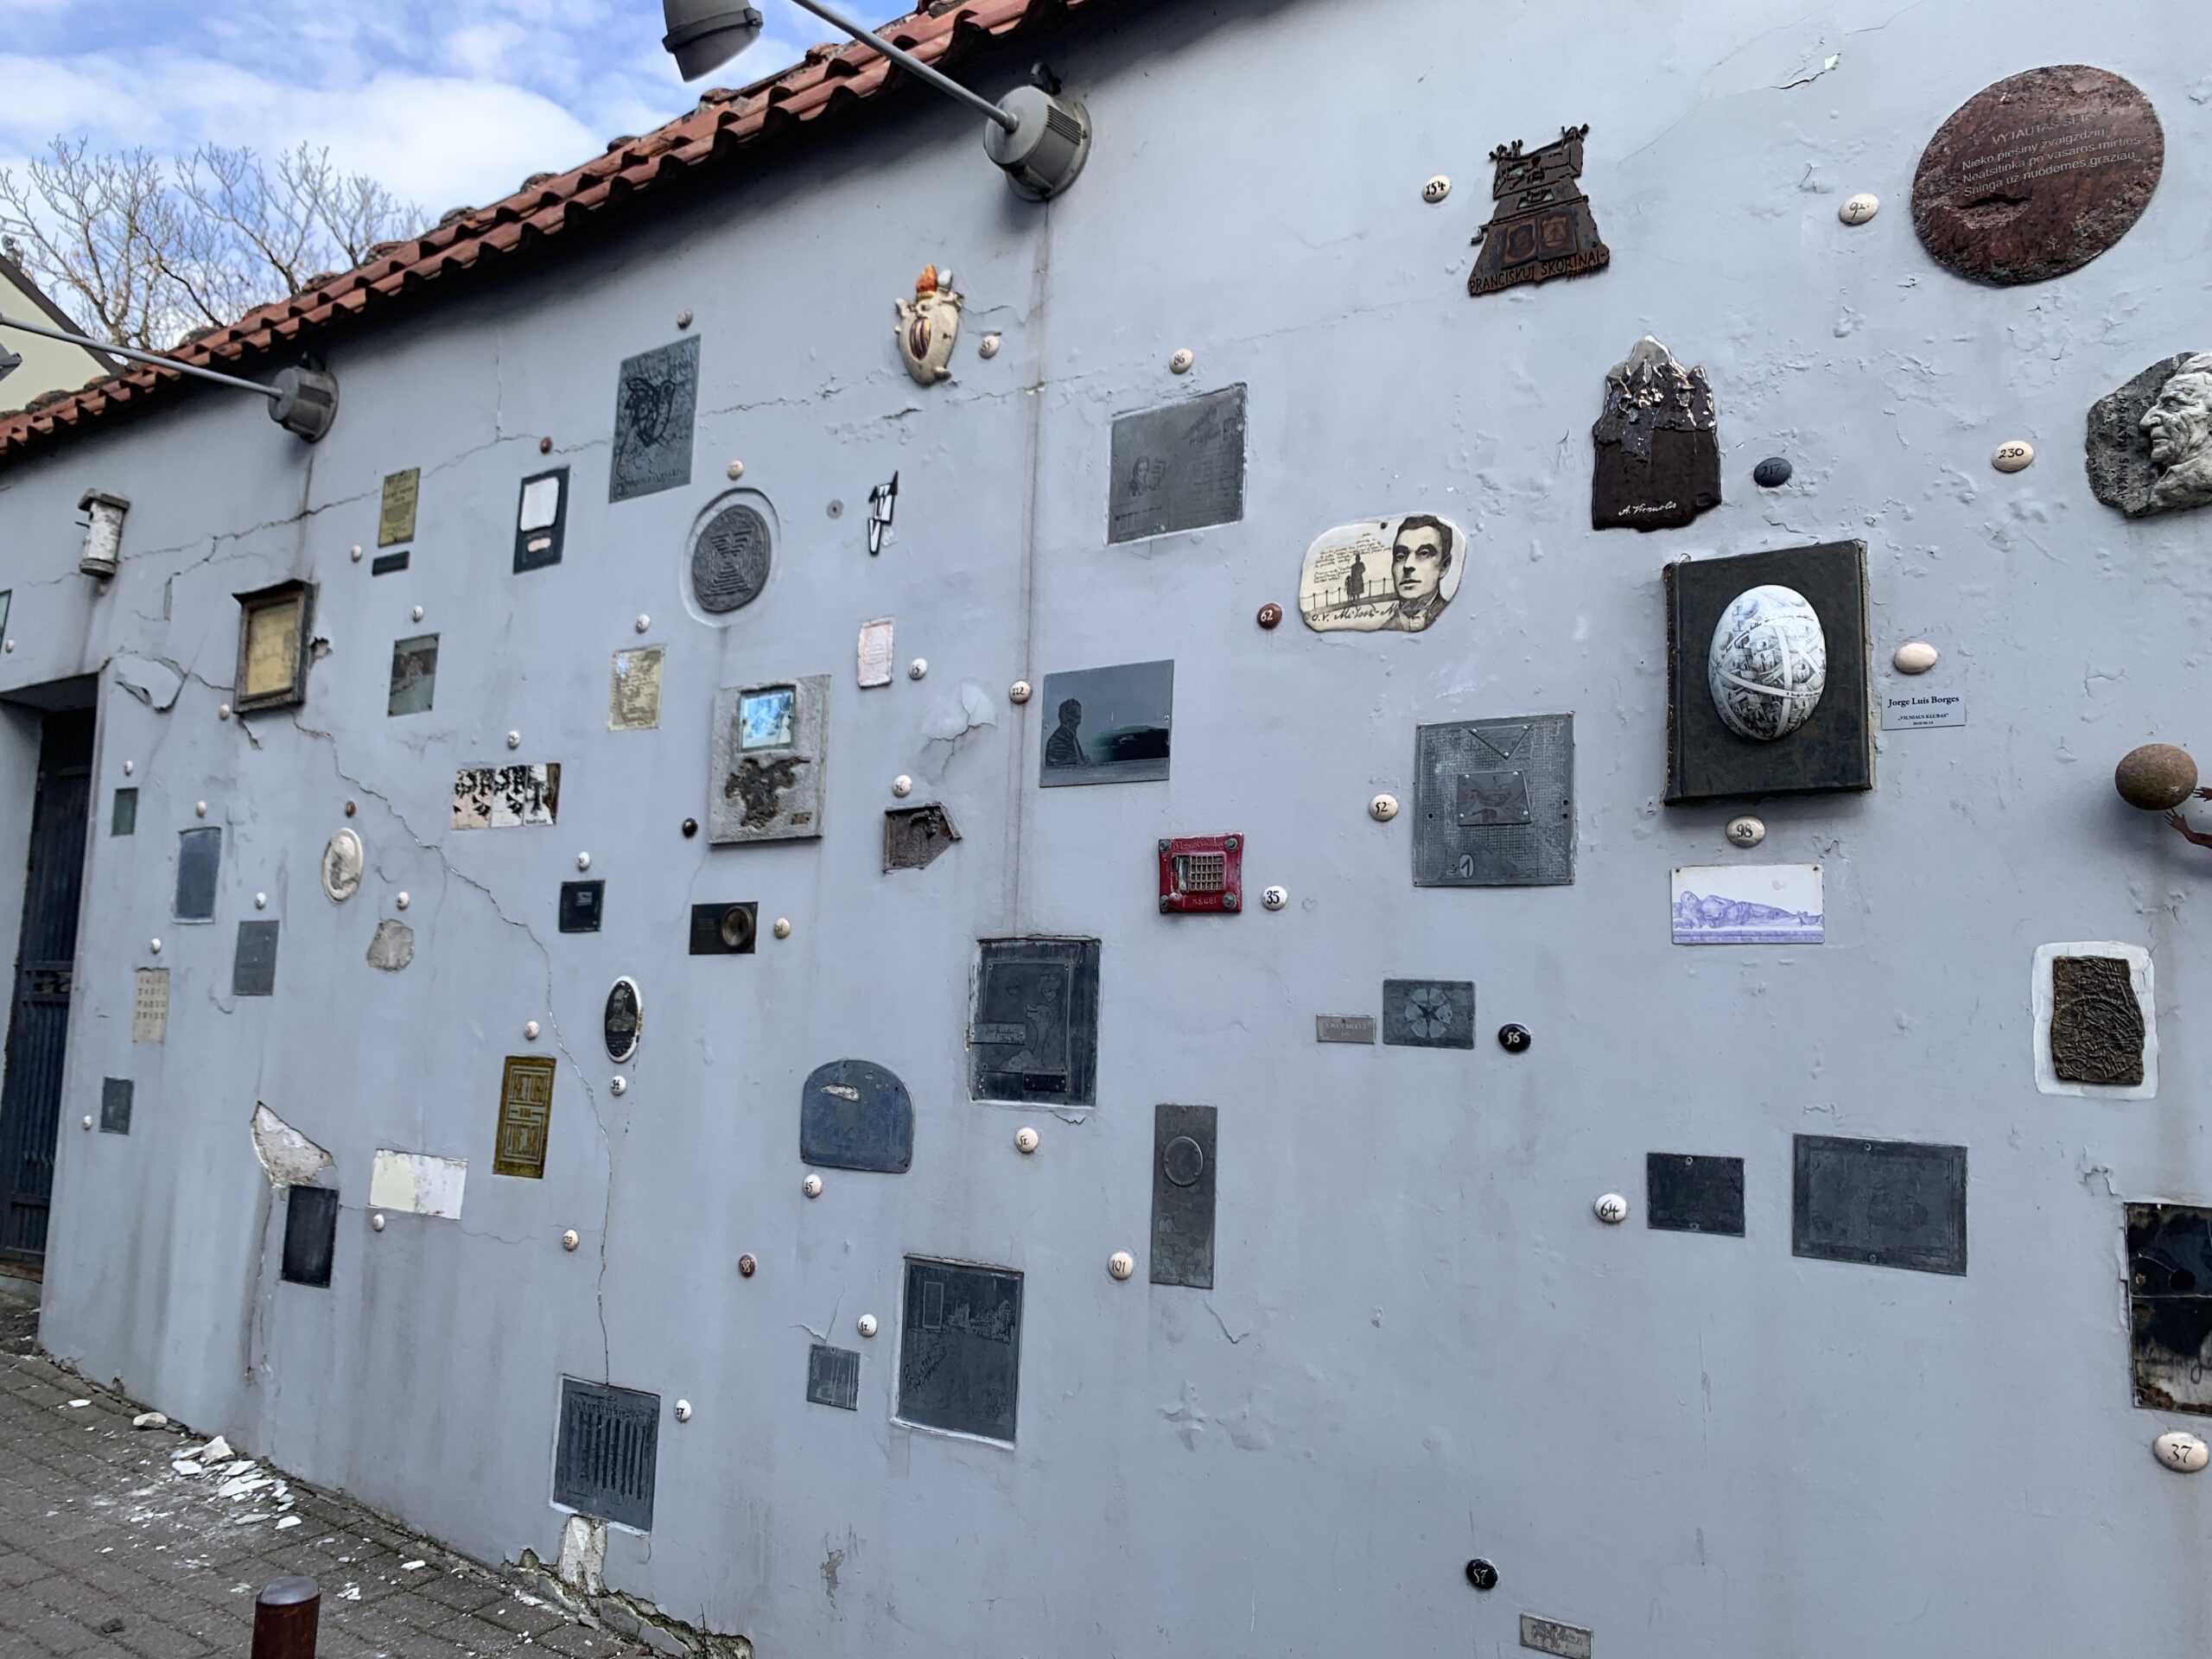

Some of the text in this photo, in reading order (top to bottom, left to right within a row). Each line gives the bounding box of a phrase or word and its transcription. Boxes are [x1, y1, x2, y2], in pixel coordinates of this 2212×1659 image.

[1962, 155, 1994, 171] Nieko
[2028, 156, 2044, 168] po
[1963, 179, 2003, 197] Sninga
[1998, 448, 2024, 460] 230
[1887, 696, 1960, 709] Jorge Luis Borges
[1375, 801, 1389, 815] 52
[1737, 823, 1753, 838] 98
[1266, 890, 1281, 905] 35
[1506, 1031, 1521, 1046] 56
[1600, 1199, 1620, 1220] 64
[1111, 1258, 1126, 1273] 101
[2167, 1443, 2193, 1464] 37
[1473, 1567, 1488, 1586] 57
